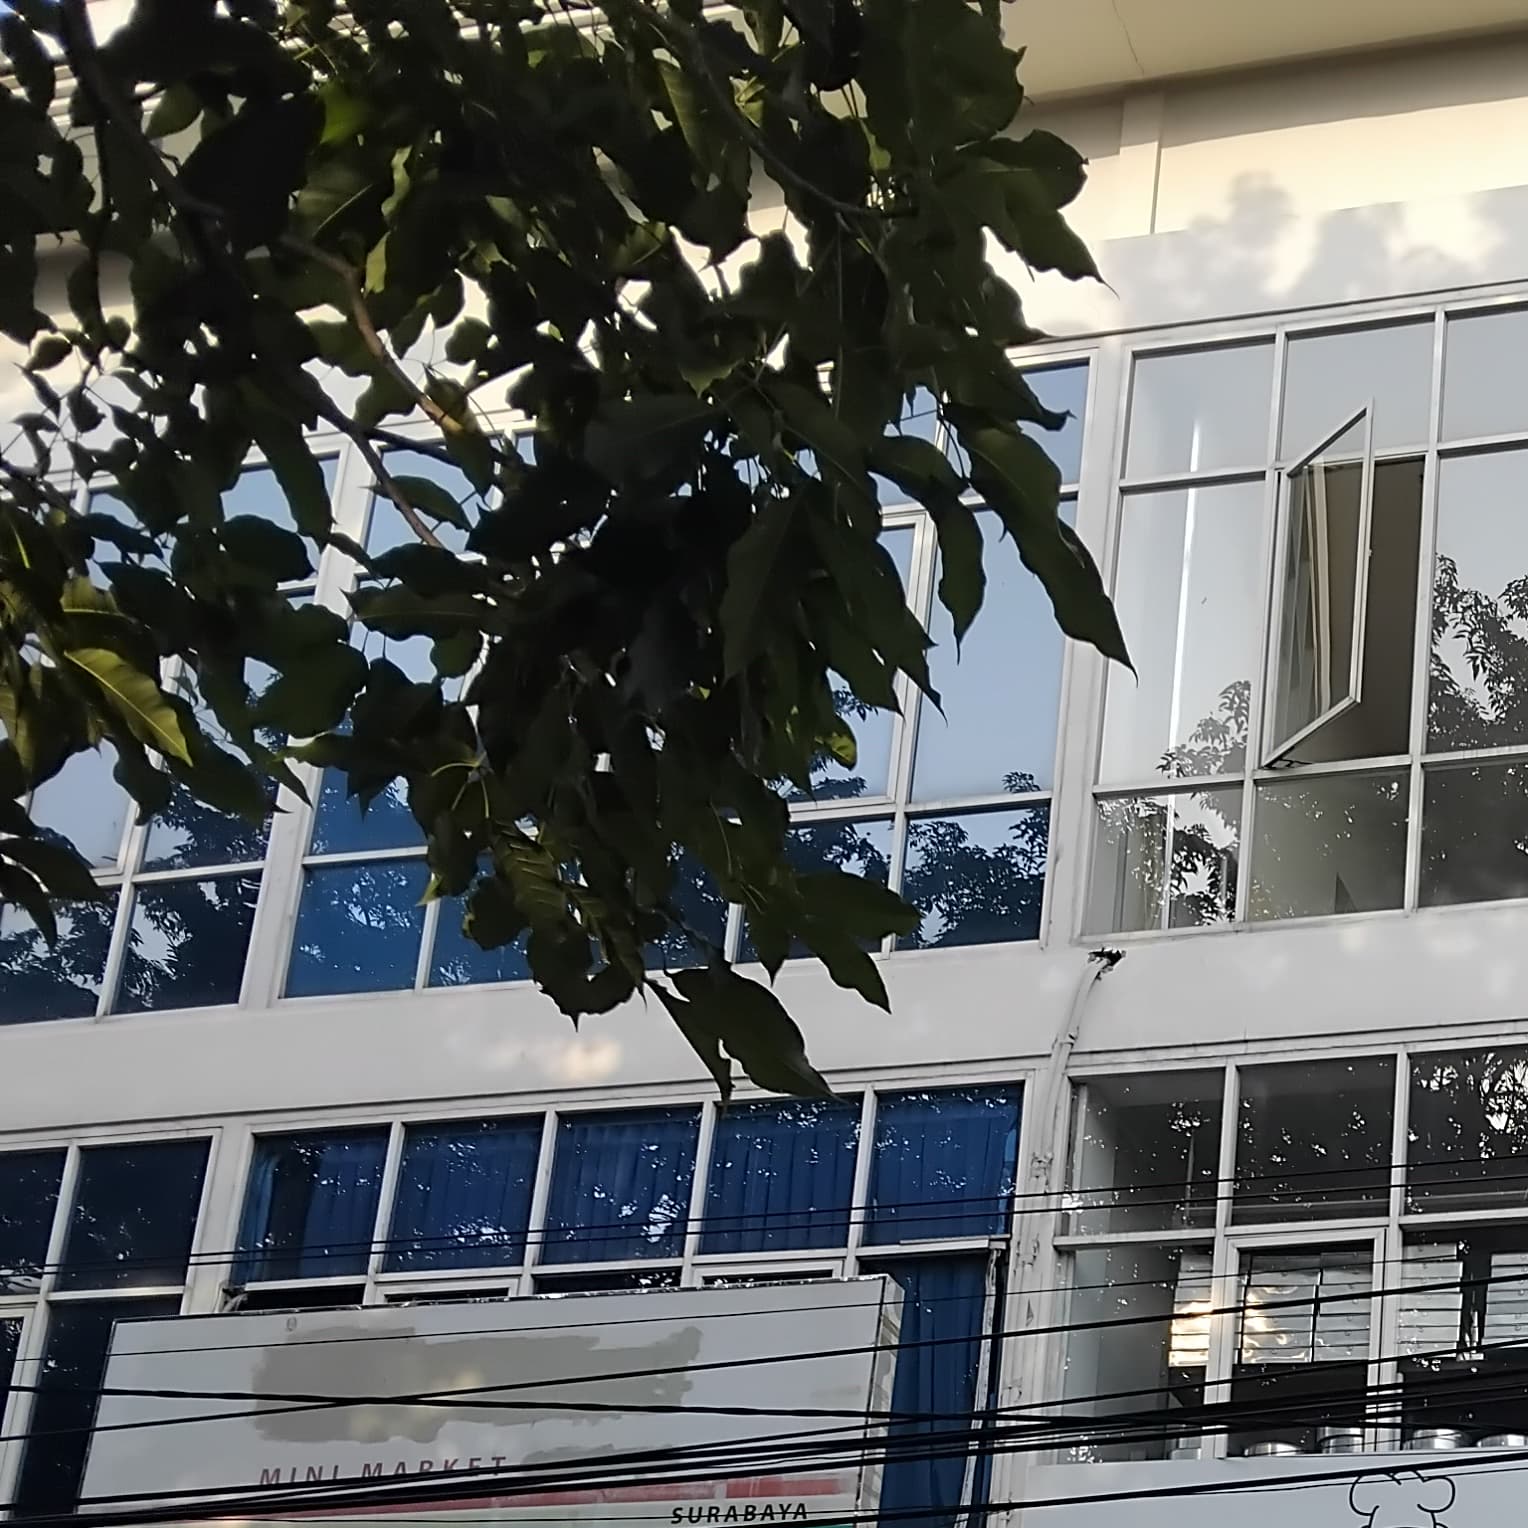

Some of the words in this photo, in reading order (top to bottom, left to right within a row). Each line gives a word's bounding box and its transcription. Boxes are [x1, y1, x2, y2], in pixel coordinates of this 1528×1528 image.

[260, 1465, 339, 1486] MINI
[361, 1456, 506, 1478] MARKET
[671, 1503, 808, 1525] SURABAYA
